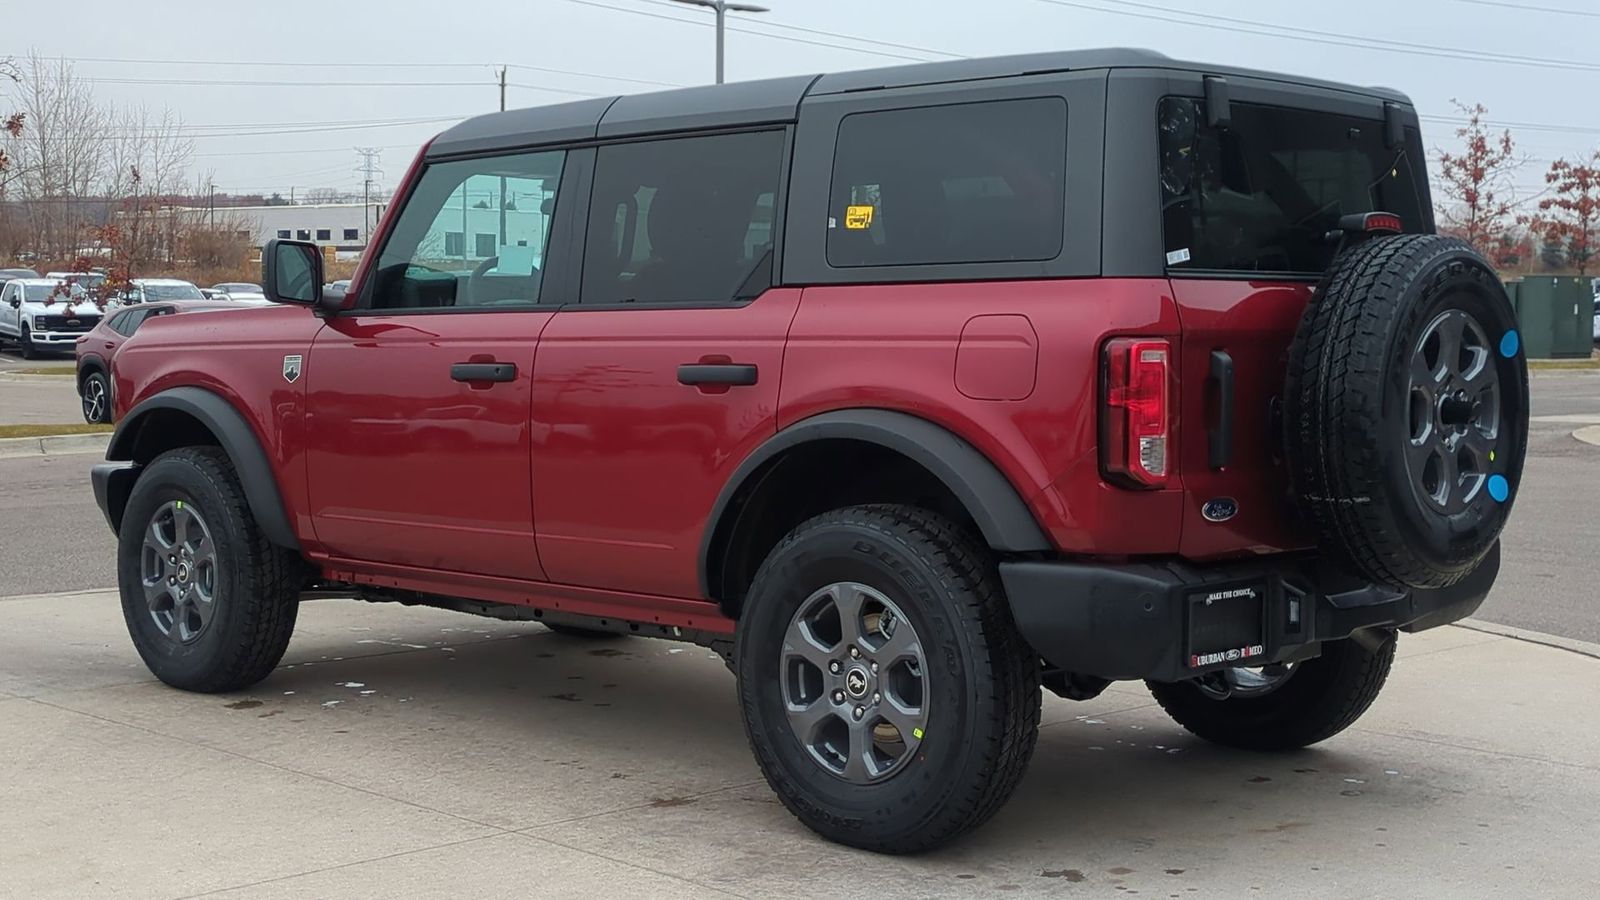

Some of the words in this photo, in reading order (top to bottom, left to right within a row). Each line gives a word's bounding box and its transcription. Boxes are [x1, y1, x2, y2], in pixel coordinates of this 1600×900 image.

[1209, 591, 1222, 601] MAKE
[1223, 590, 1232, 599] THE
[1191, 651, 1226, 667] SUBURBAN
